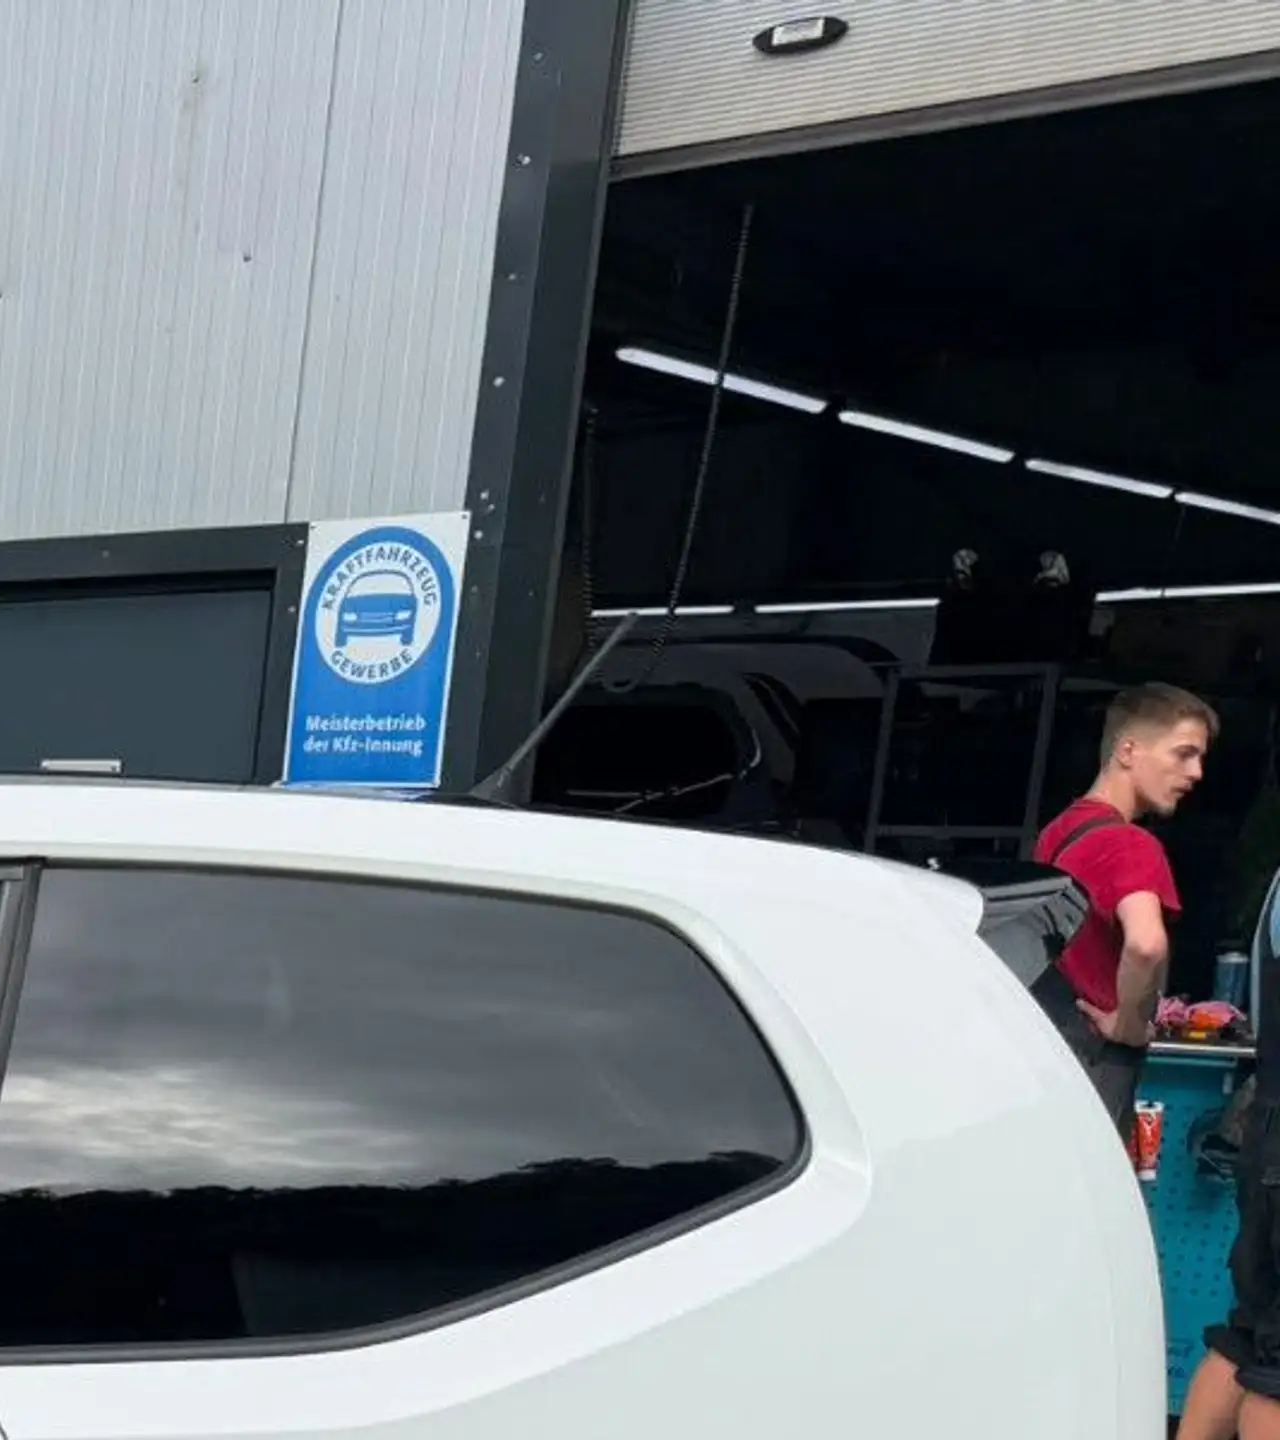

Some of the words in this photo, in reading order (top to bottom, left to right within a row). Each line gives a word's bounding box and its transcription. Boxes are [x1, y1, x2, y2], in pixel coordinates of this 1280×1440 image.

[321, 545, 438, 610] KRAFTFAHRZEUG
[331, 649, 413, 680] GEWERBE
[306, 714, 427, 732] Meisterbetrieb
[303, 735, 328, 753] der
[332, 735, 424, 757] Kfz-Innung
